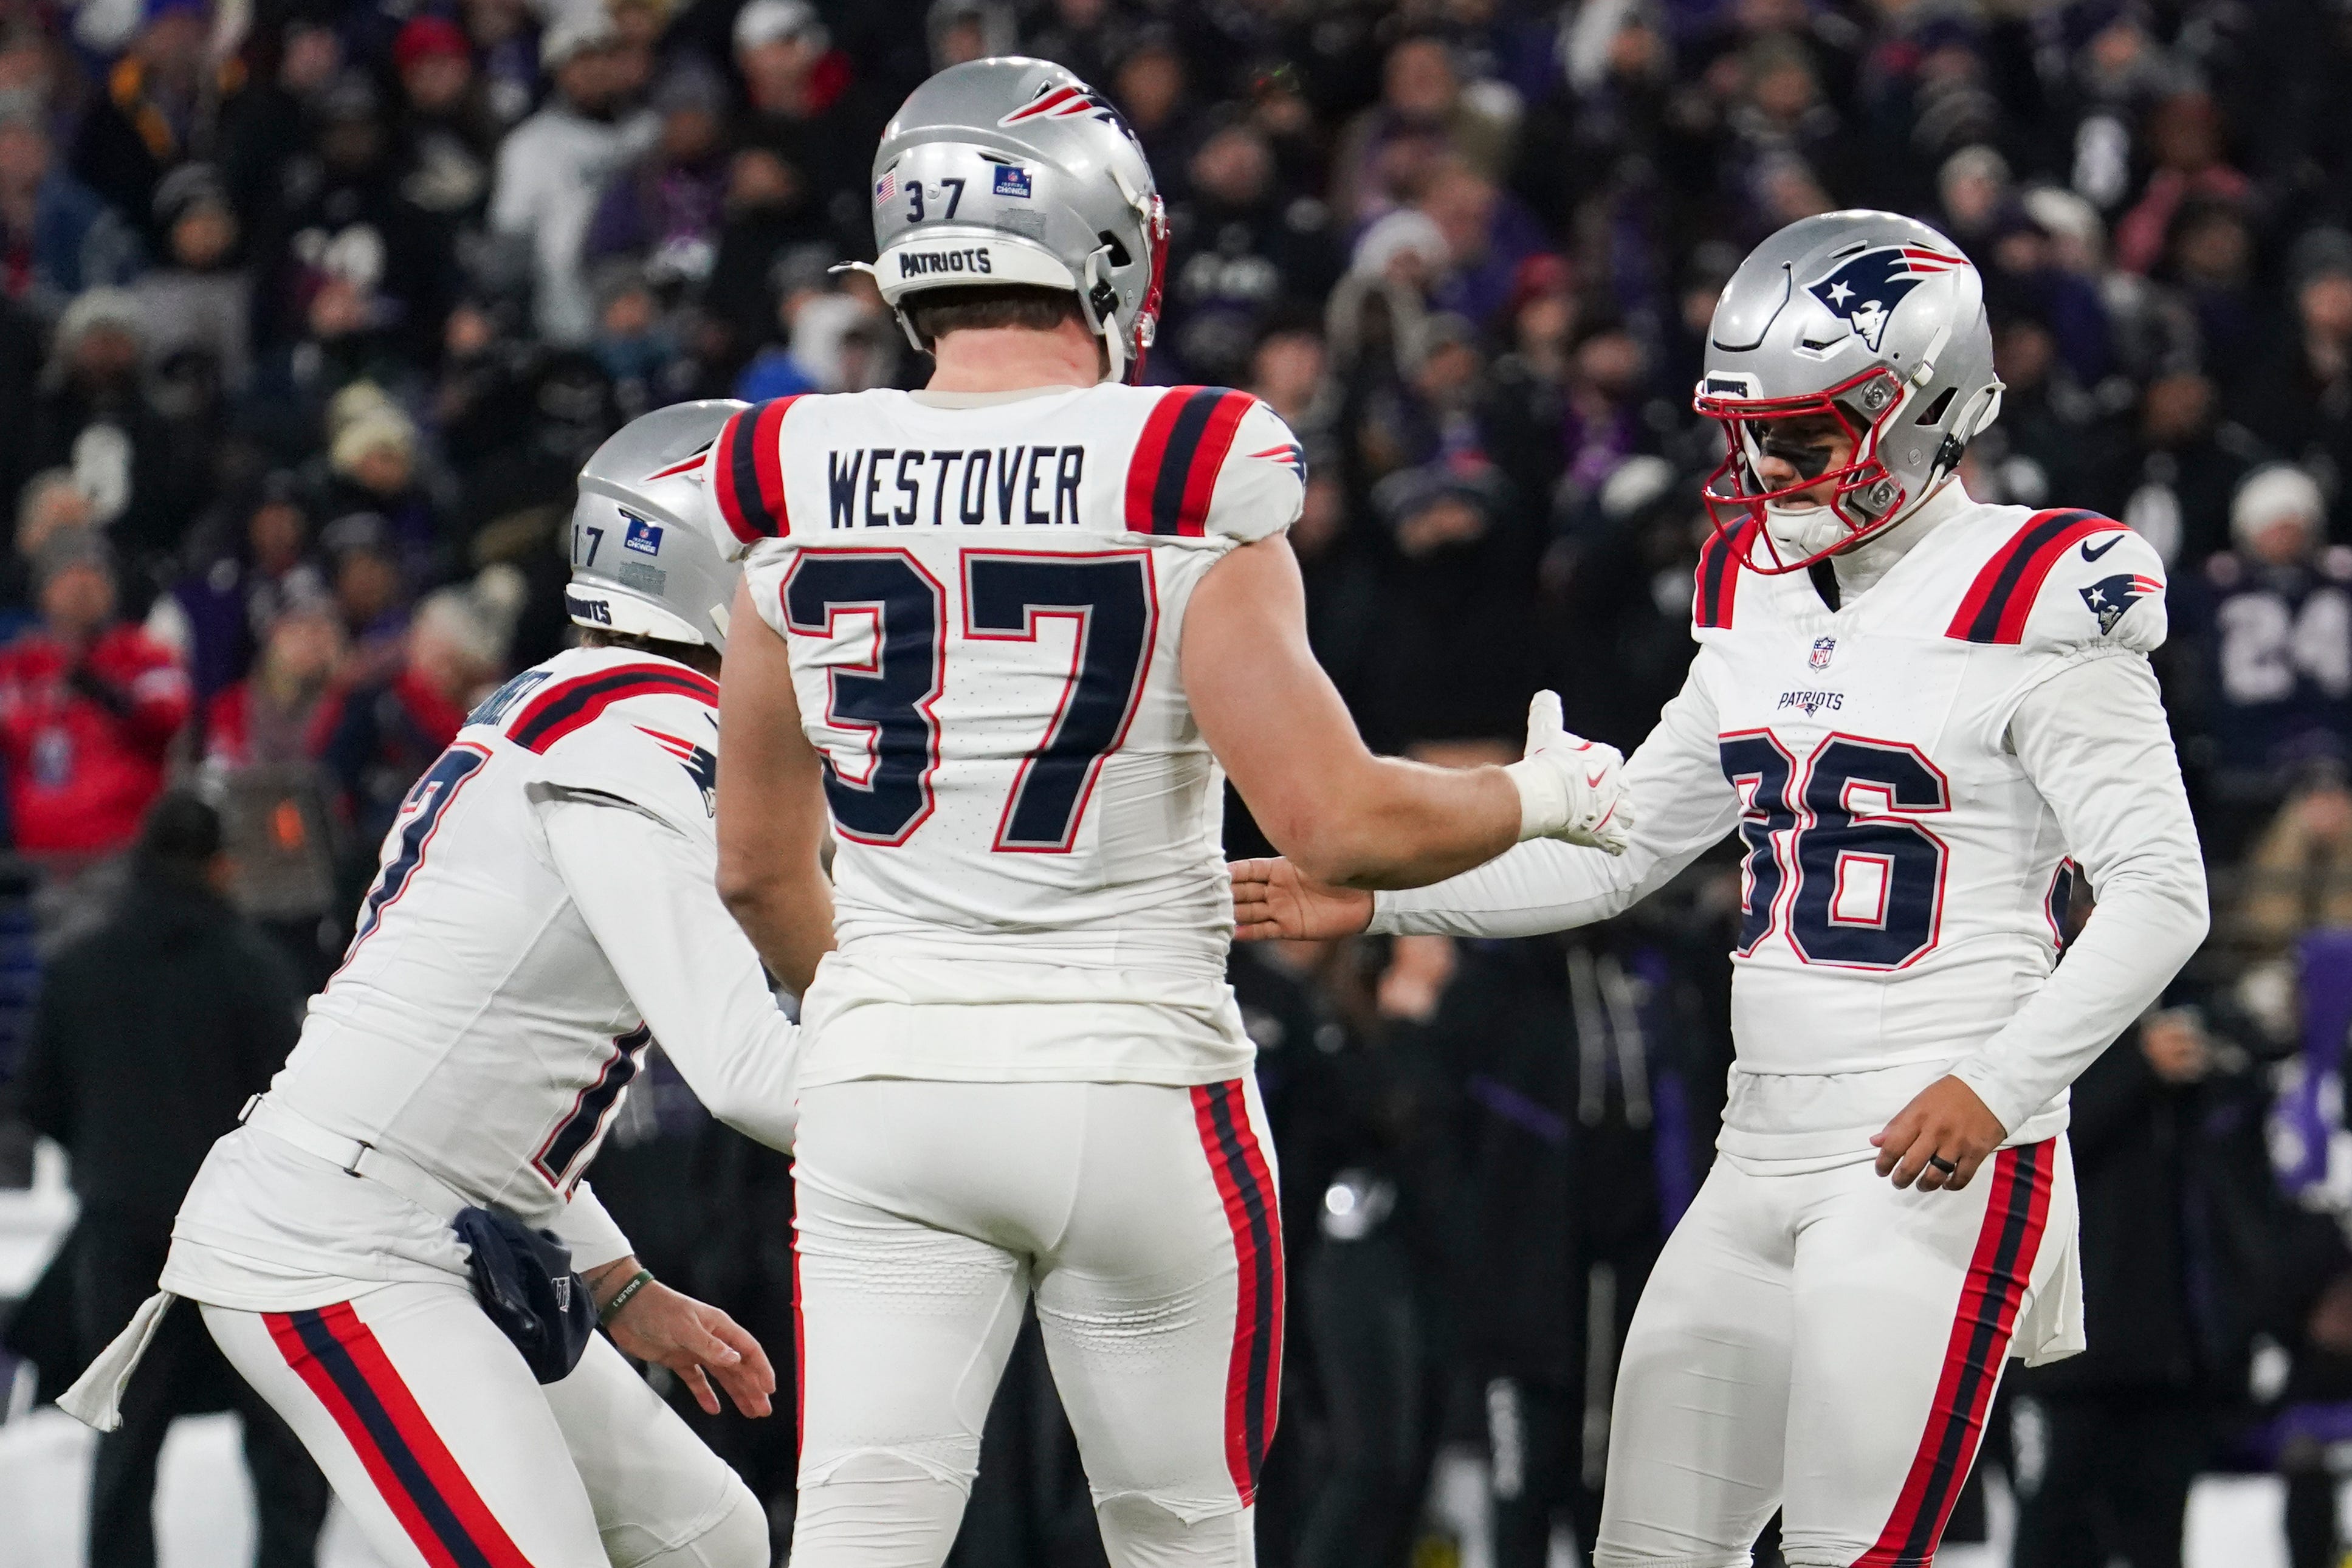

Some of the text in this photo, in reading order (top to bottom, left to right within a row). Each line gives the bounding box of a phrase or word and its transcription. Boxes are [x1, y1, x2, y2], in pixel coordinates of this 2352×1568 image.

[905, 177, 966, 223] 37
[899, 247, 991, 278] PATRIOTS
[828, 445, 1084, 528] WESTOVER
[574, 524, 604, 567] 17
[1812, 650, 1829, 664] NFL
[779, 546, 1158, 853] 37
[1778, 691, 1844, 710] PATRIOTS
[616, 1279, 640, 1303] SADLER
